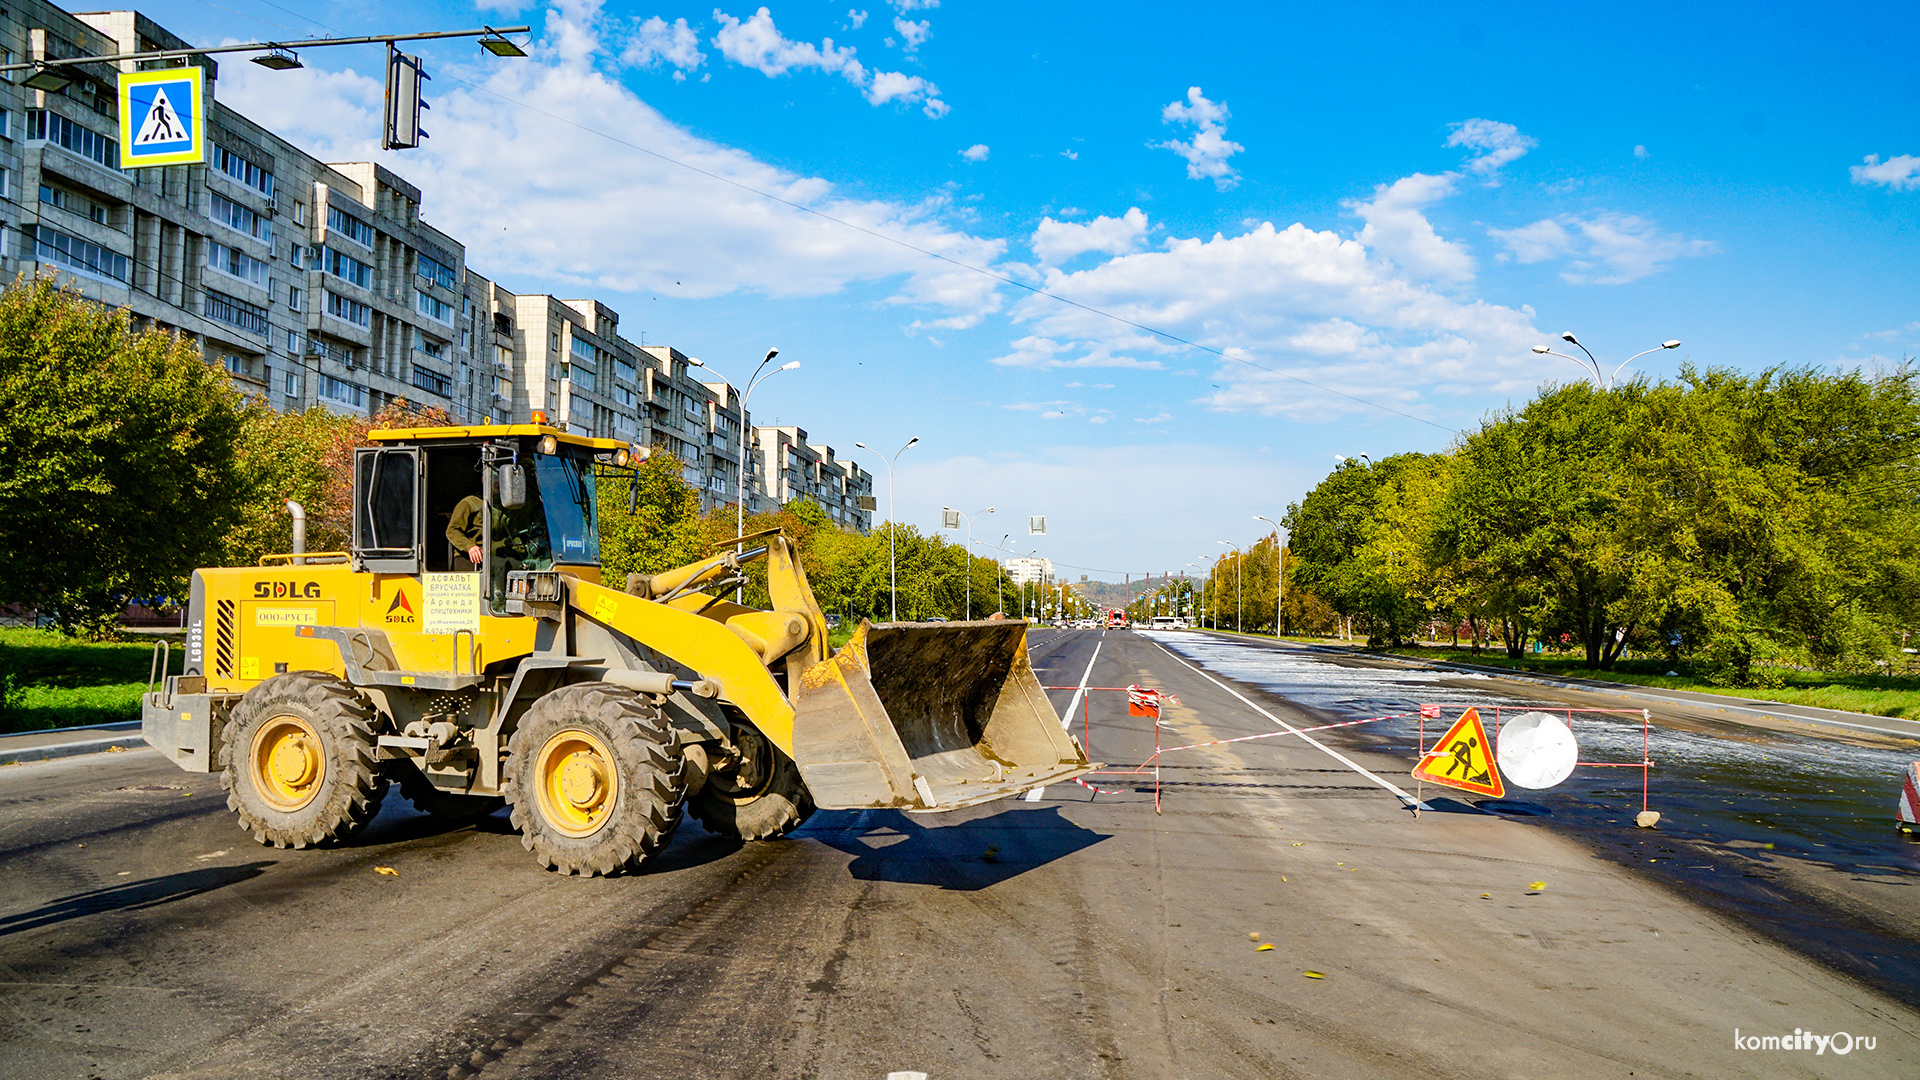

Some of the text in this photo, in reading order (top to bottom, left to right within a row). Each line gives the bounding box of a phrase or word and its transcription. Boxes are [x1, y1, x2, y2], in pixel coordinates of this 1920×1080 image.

[431, 574, 471, 583] АСФАЛЬТ
[254, 581, 321, 598] SDLG
[430, 583, 471, 591] БРУСЧАТКА
[430, 598, 473, 607] Аренда
[430, 608, 473, 616] спецтехники
[385, 615, 415, 623] SDLG
[190, 619, 202, 662] LG933L
